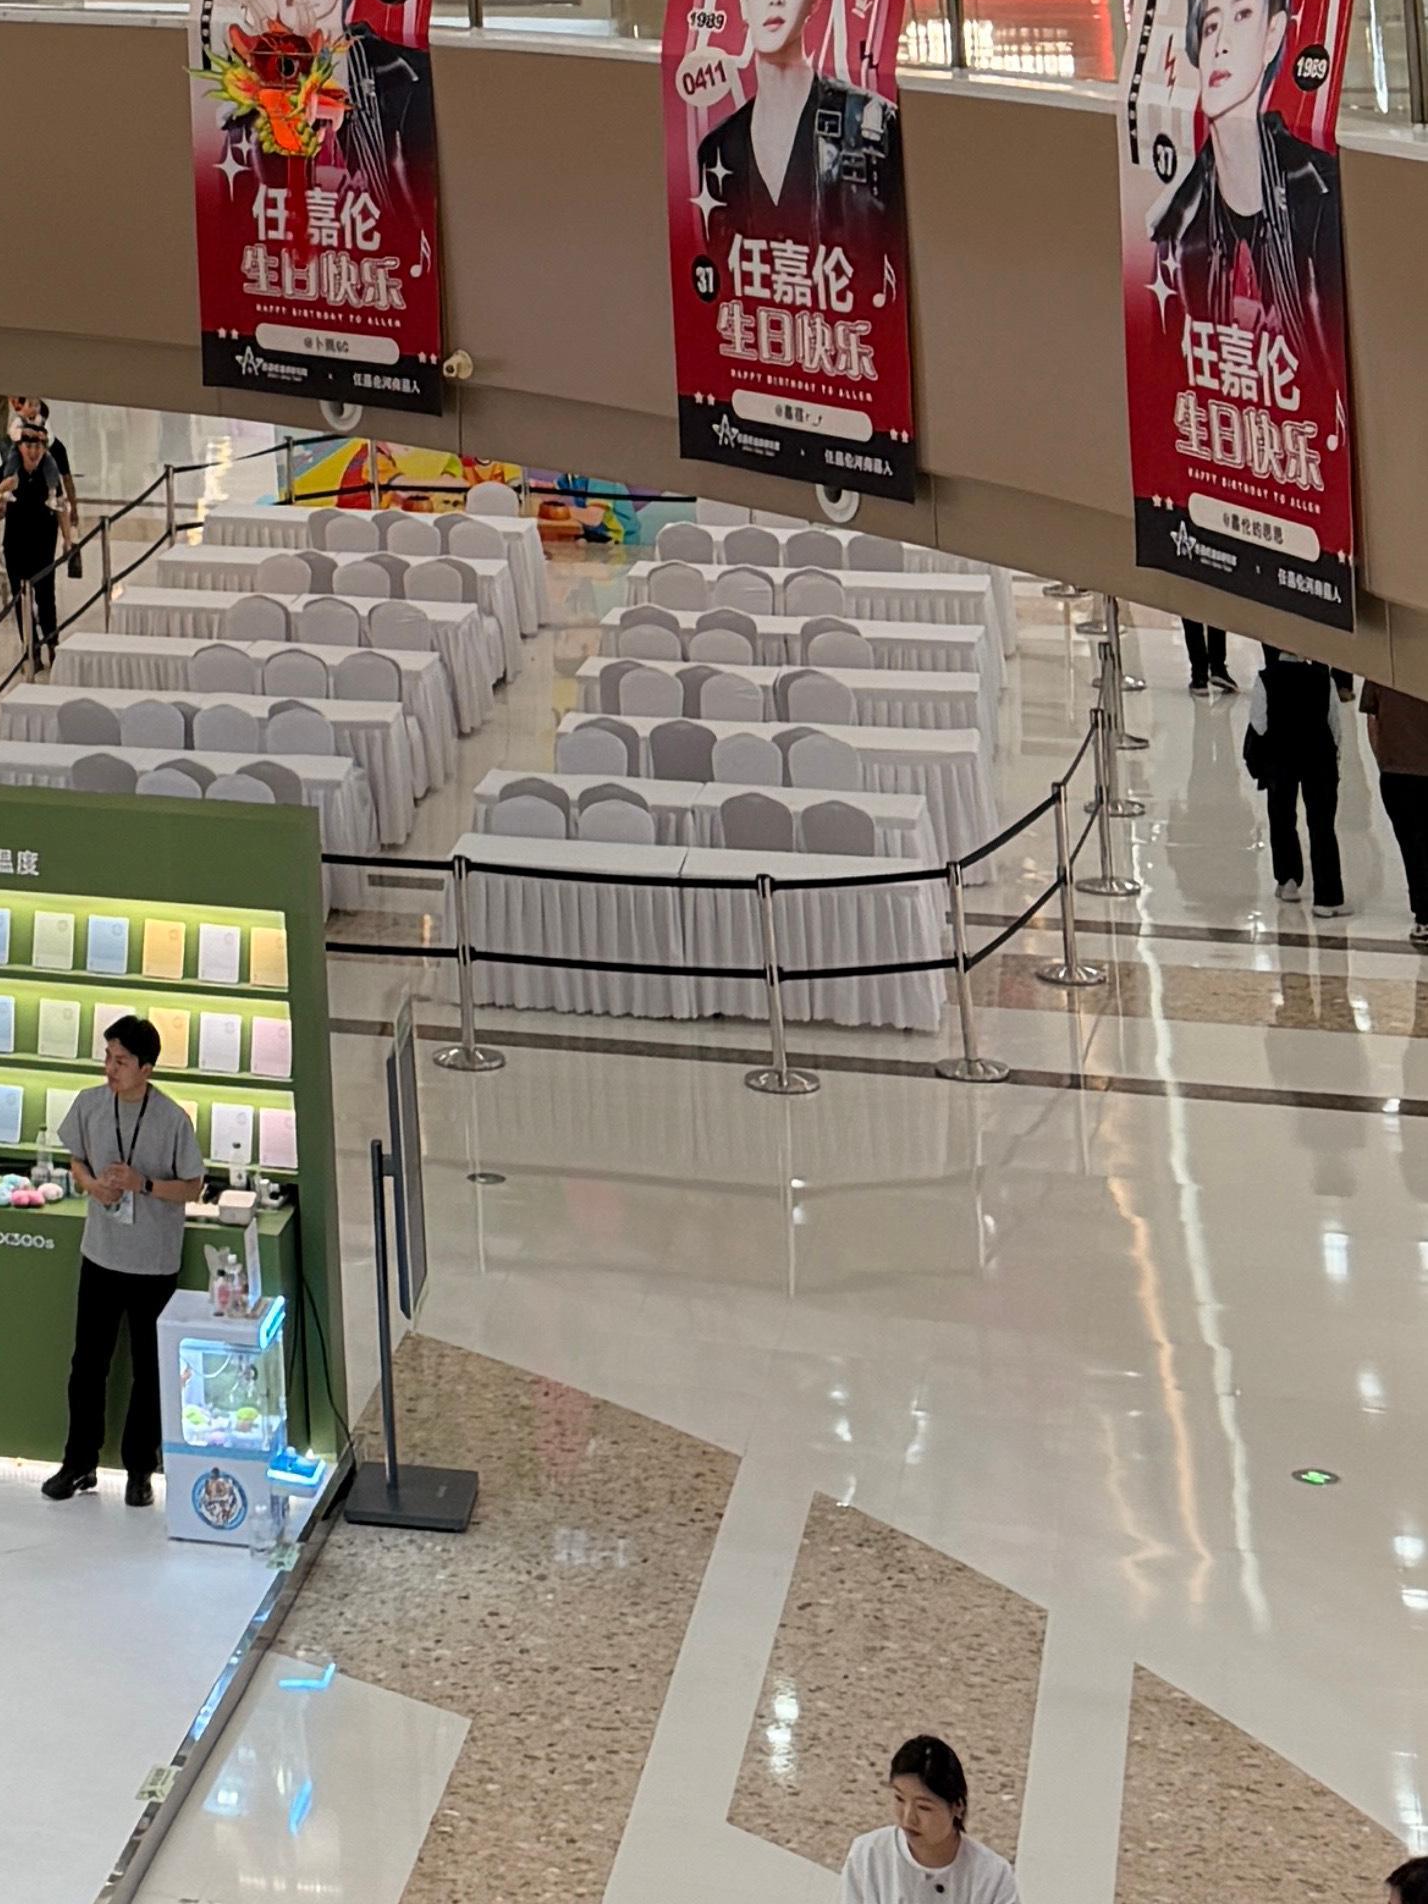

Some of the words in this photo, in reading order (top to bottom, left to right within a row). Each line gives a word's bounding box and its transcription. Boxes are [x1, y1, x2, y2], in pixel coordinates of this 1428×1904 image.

[683, 63, 726, 95] 0411
[252, 188, 381, 251] 任嘉伦
[240, 244, 405, 310] 生日快乐
[729, 235, 854, 312] 任嘉伦
[717, 300, 878, 382] 生日快乐
[1182, 316, 1299, 412] 任嘉伦
[1175, 391, 1323, 492] 生日快乐
[0, 1232, 55, 1249] X300s
